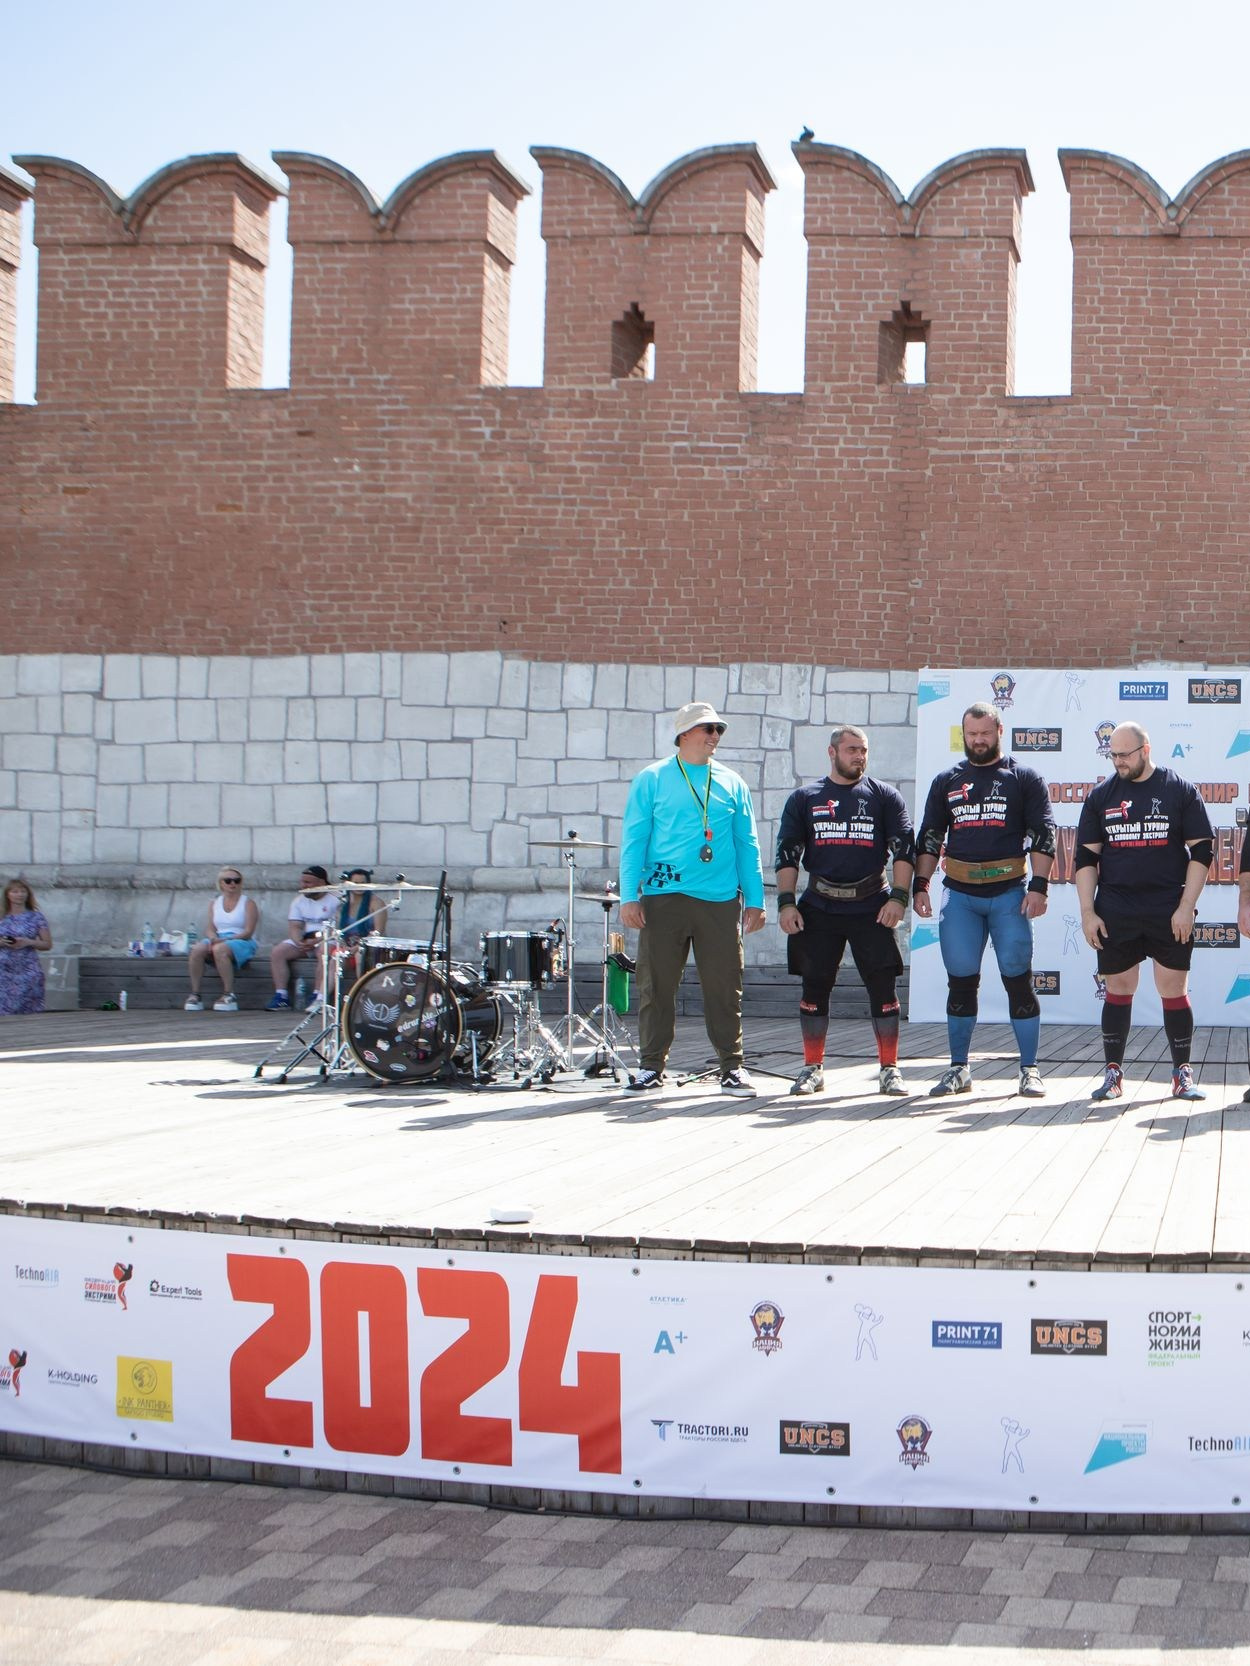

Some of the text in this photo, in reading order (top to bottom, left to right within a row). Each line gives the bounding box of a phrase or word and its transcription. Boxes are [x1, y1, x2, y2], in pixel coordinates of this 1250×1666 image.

[1122, 684, 1166, 695] PRINT 71
[1191, 684, 1238, 697] UNCS
[1014, 732, 1059, 745] UNCS
[15, 1264, 60, 1283] TechnoAIR
[84, 1282, 116, 1293] СИЛОВОГО
[161, 1284, 182, 1296] Expert
[184, 1287, 202, 1297] Tools
[84, 1291, 117, 1301] ЭКСТРИМА
[1148, 1311, 1192, 1323] СПОРТ
[937, 1325, 998, 1340] PRINT 71
[1036, 1326, 1102, 1345] UNCS
[1148, 1325, 1201, 1338] НОРМА
[1148, 1338, 1201, 1351] ЖИЗНИ
[226, 1252, 622, 1475] 2024
[48, 1367, 98, 1385] K-HOLDING
[677, 1423, 749, 1437] TRACTORI.RU
[784, 1427, 845, 1446] UNCS
